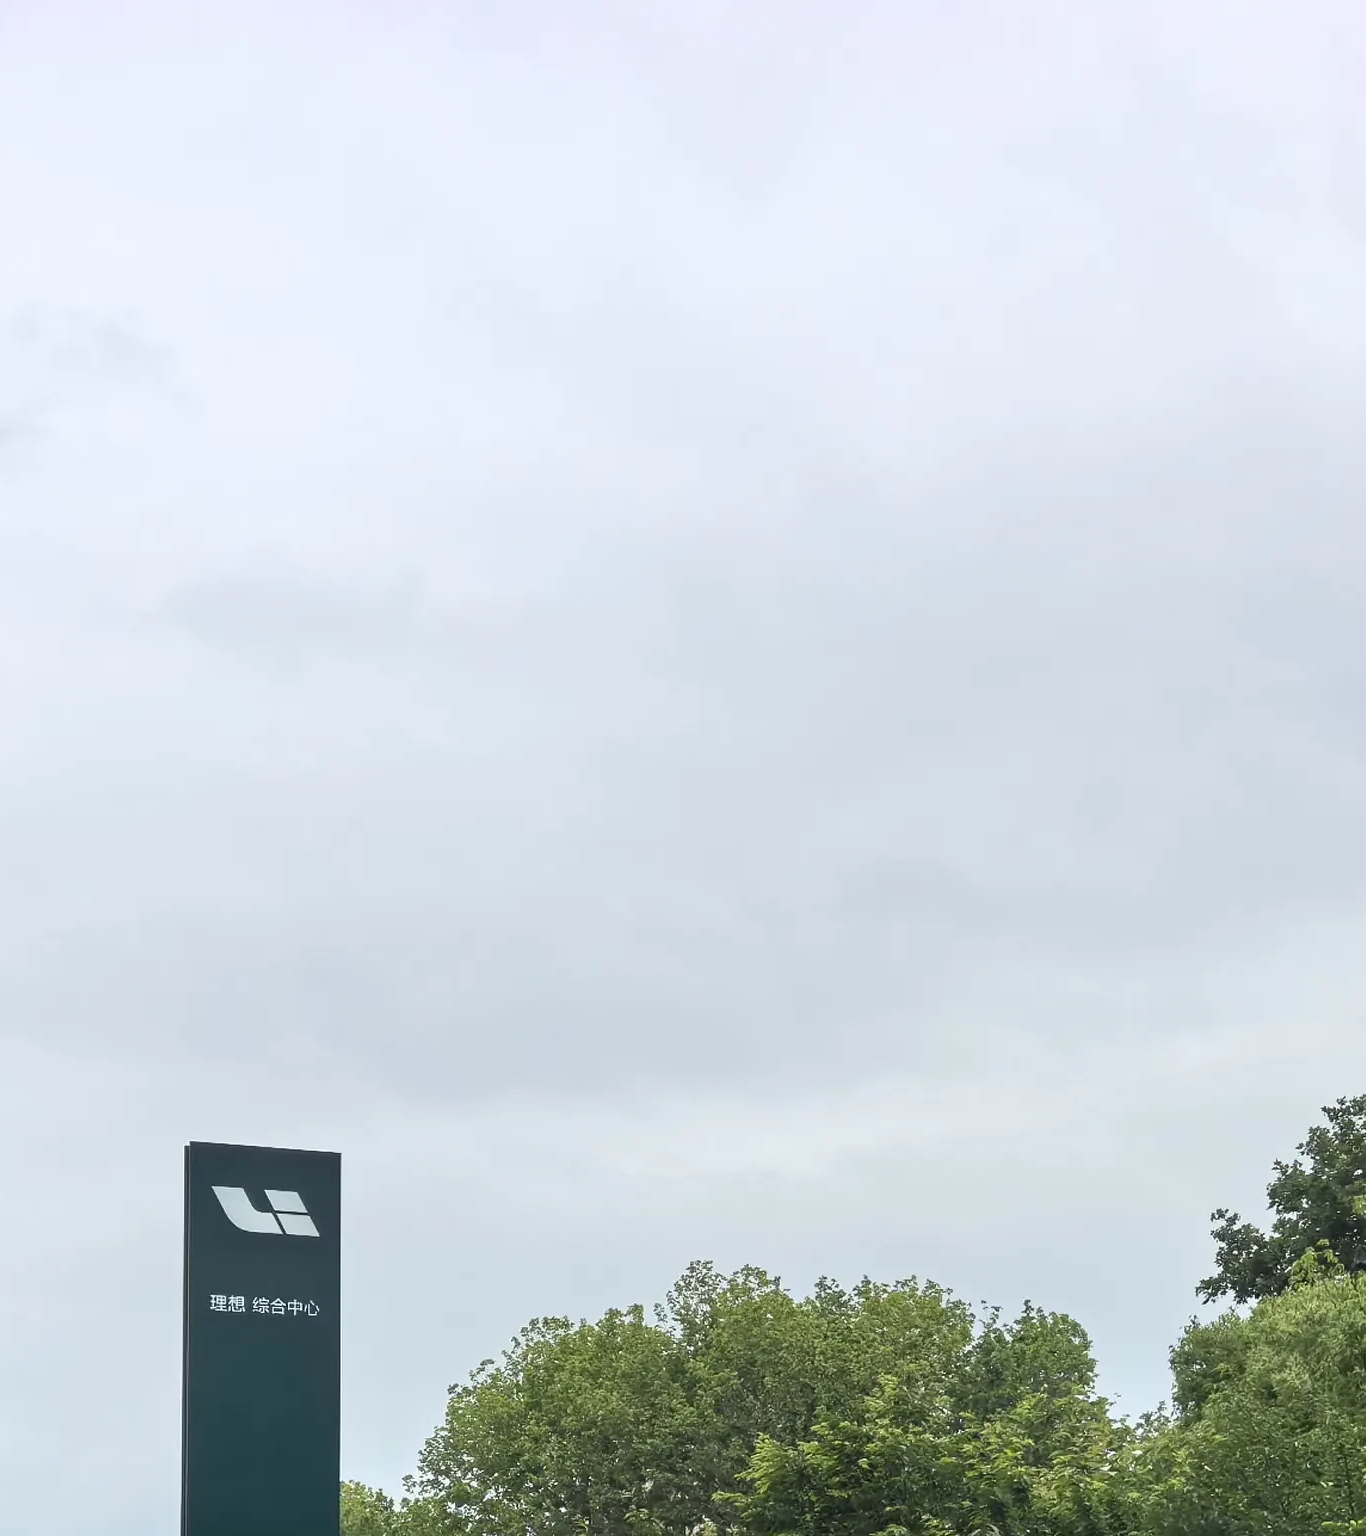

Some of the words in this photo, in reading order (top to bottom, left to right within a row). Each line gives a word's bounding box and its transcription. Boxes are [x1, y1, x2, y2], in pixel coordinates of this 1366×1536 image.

[209, 1294, 246, 1313] 理想
[252, 1296, 320, 1317] 综合中心
